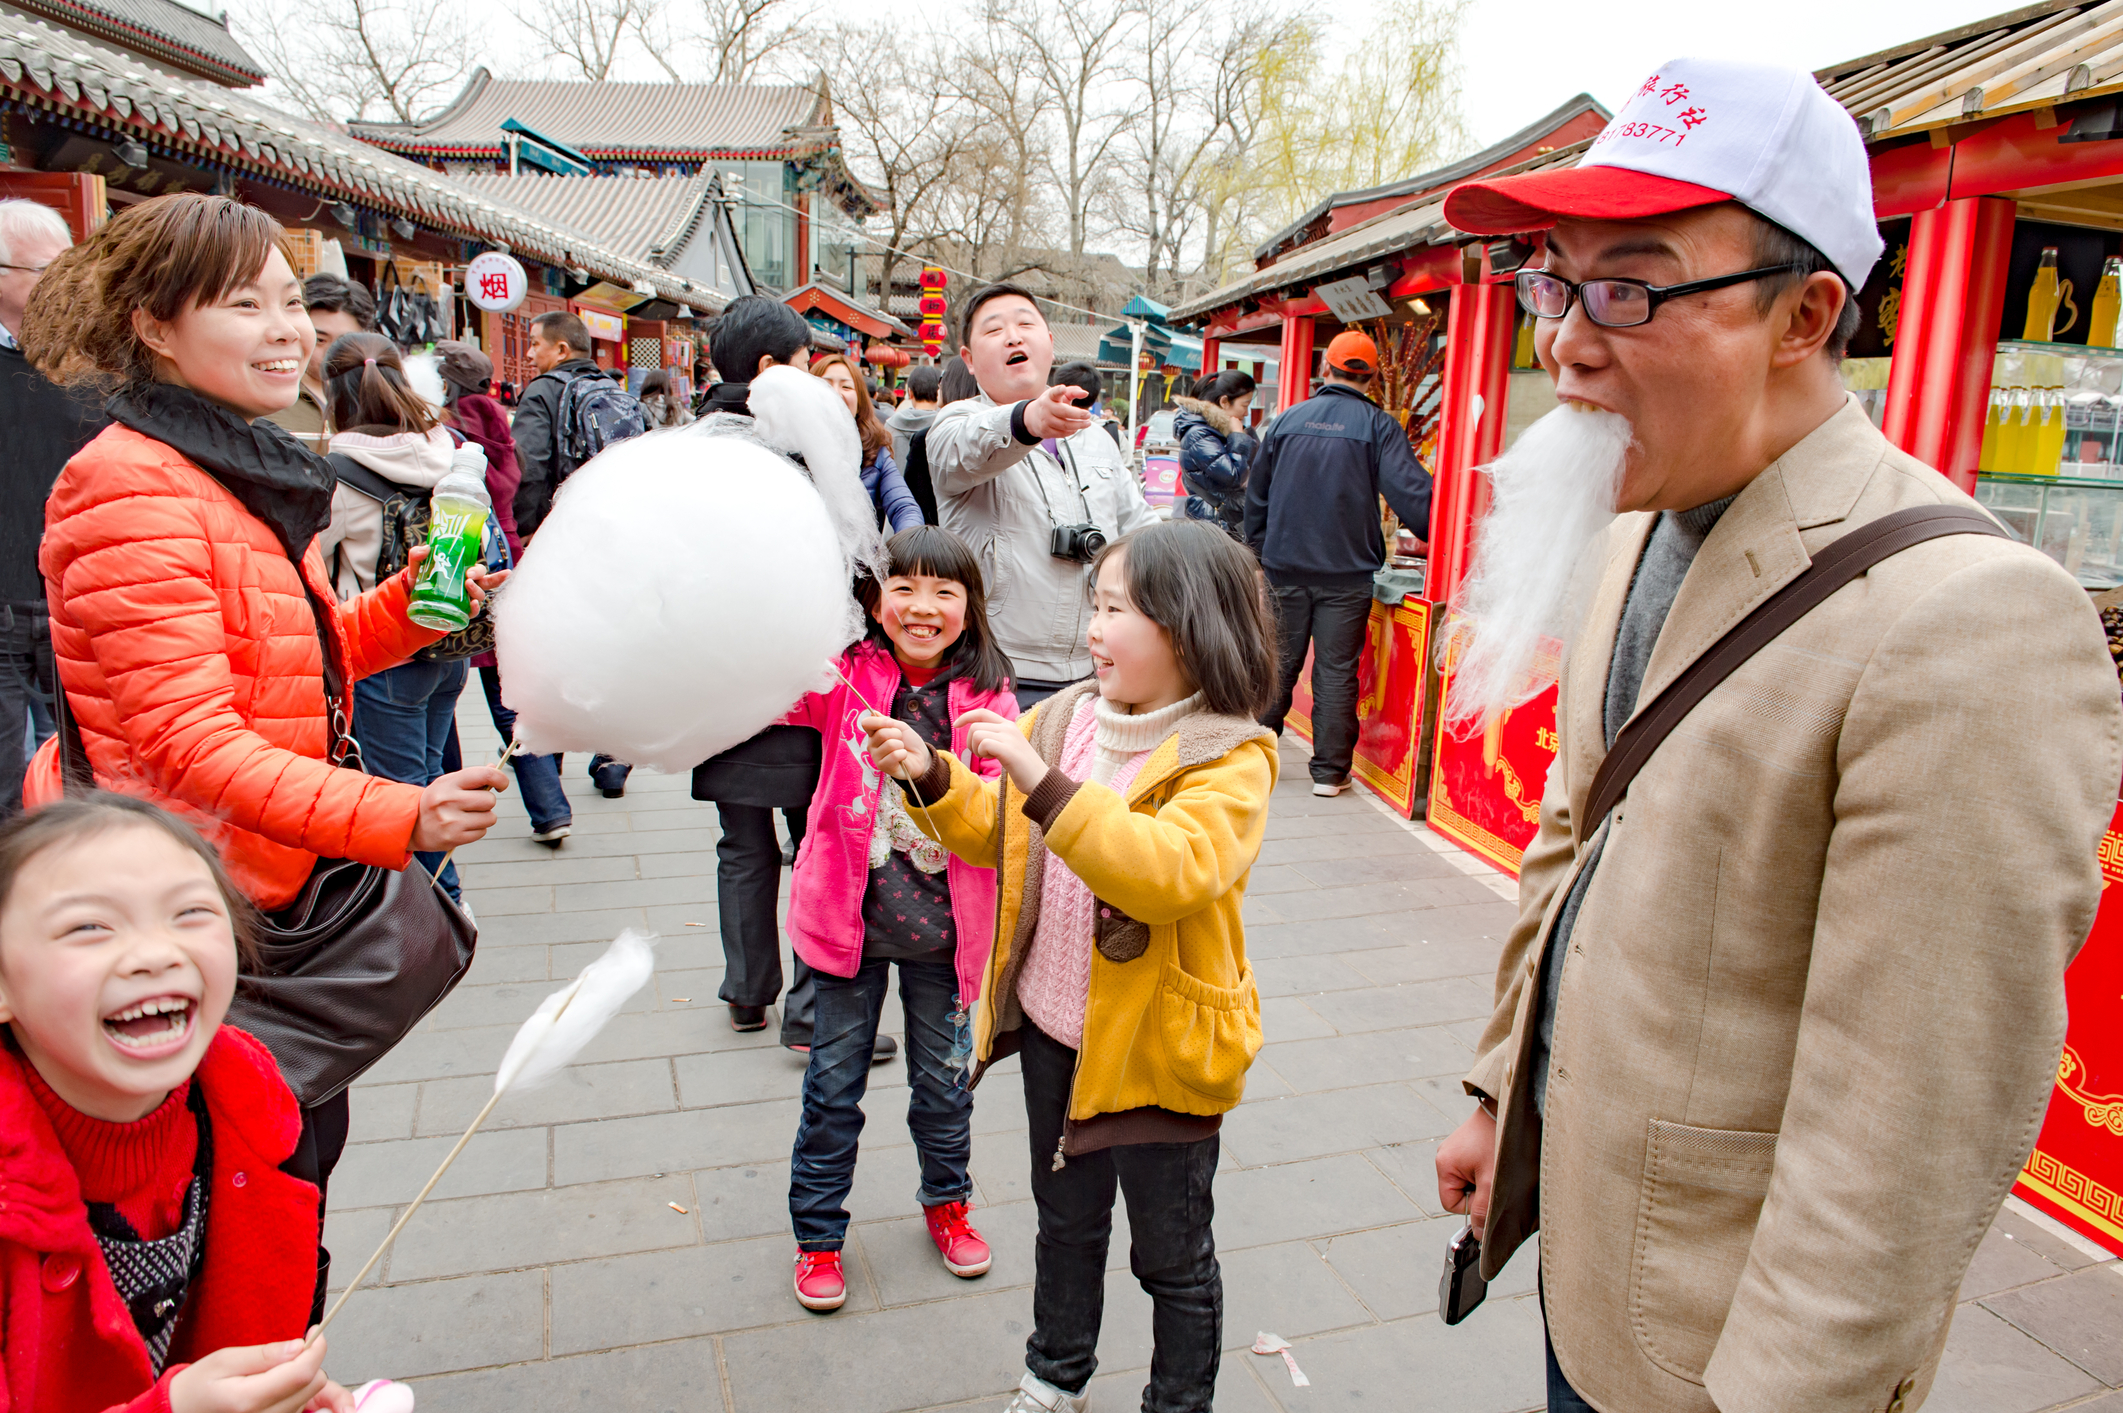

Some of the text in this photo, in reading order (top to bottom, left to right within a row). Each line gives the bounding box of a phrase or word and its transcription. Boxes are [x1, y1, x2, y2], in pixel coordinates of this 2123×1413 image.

[1620, 75, 1707, 130] 旅行社
[479, 273, 509, 300] 烟
[1535, 726, 1560, 753] 北京
